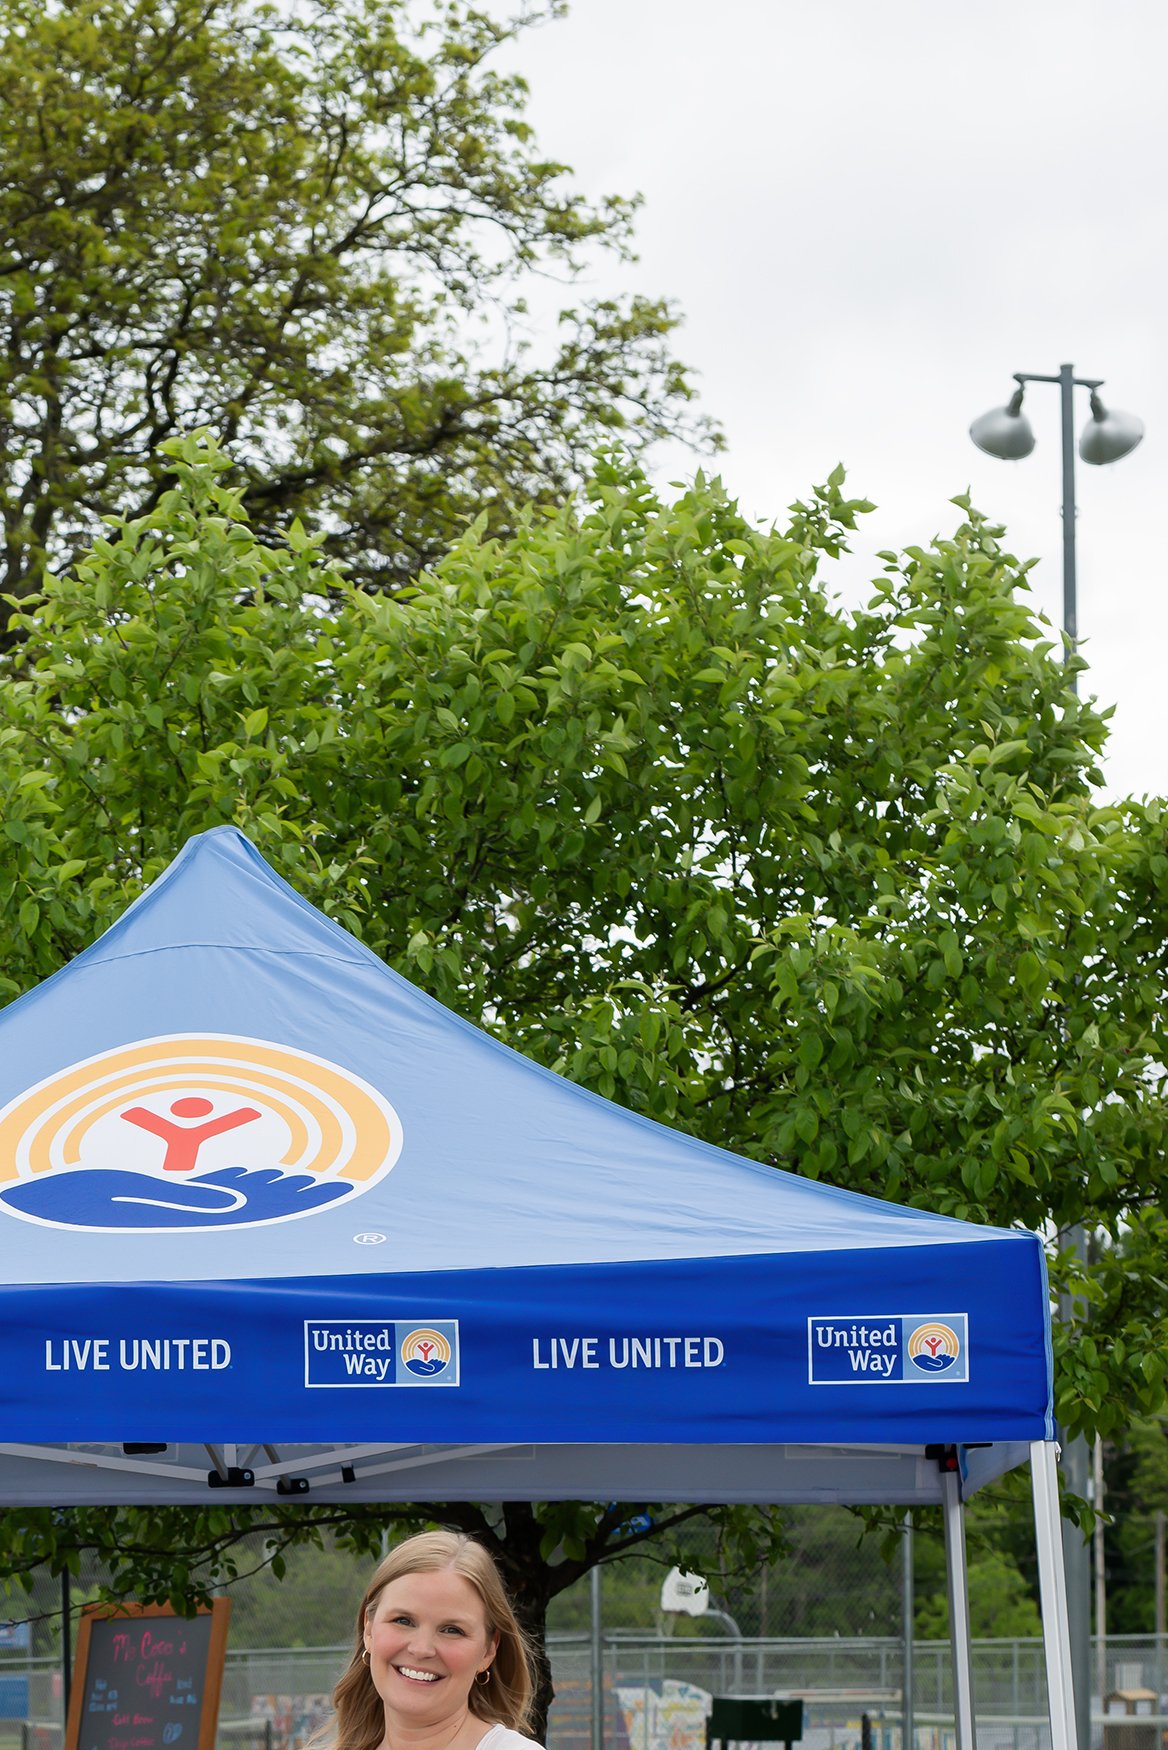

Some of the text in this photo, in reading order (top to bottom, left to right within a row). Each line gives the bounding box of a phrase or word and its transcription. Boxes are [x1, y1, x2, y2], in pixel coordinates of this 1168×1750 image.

[312, 1329, 392, 1352] United
[815, 1324, 898, 1348] United
[45, 1338, 231, 1371] LIVE UNITED
[342, 1352, 391, 1381] Way
[532, 1337, 725, 1369] LIVE UNITED
[848, 1349, 898, 1377] Way
